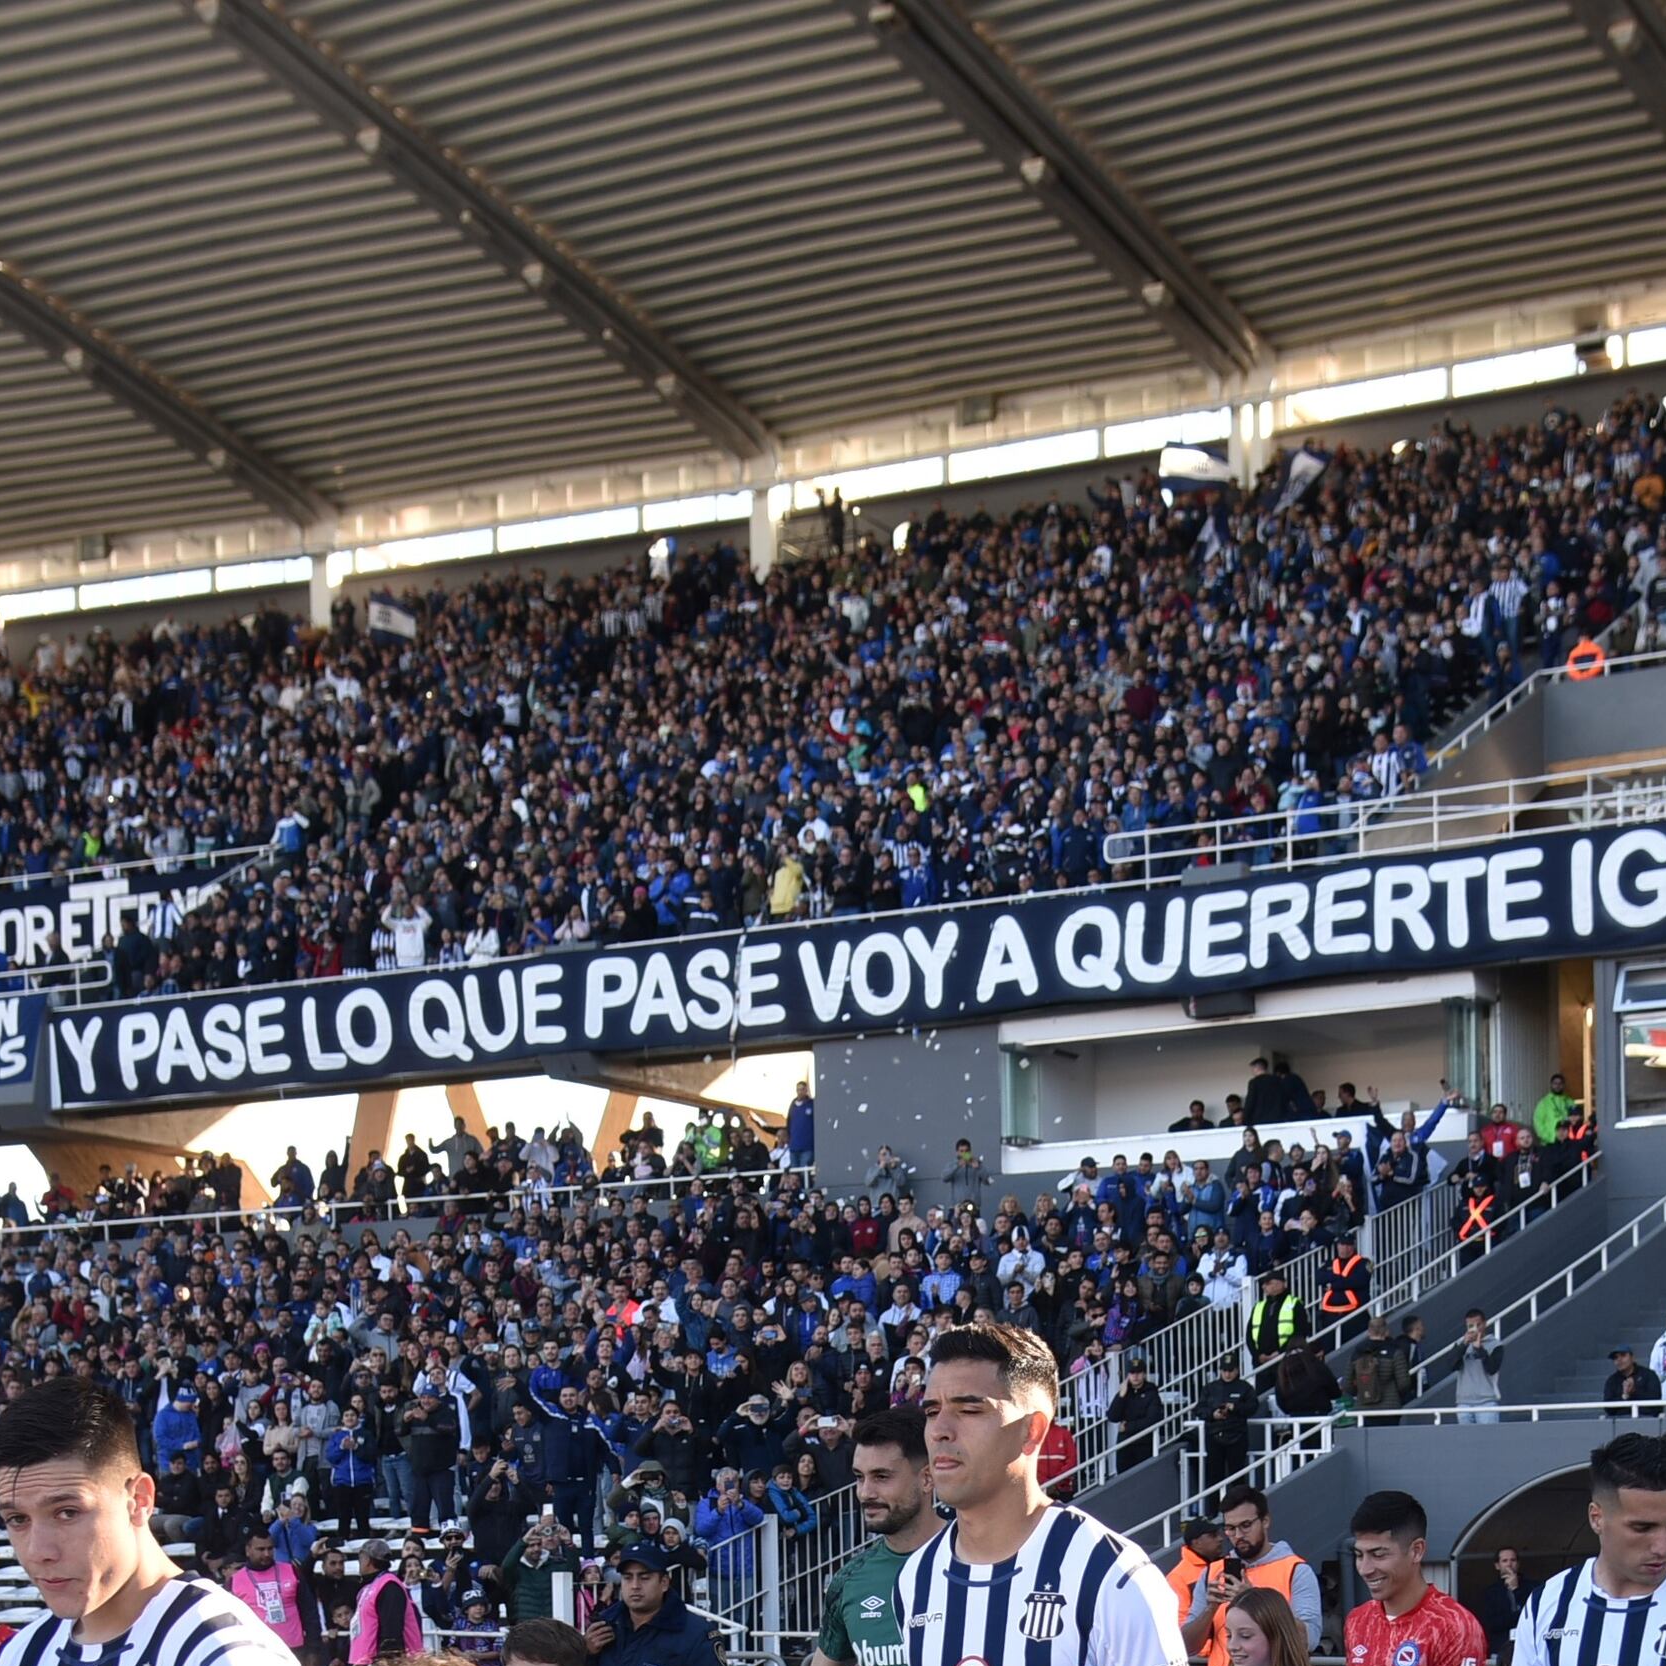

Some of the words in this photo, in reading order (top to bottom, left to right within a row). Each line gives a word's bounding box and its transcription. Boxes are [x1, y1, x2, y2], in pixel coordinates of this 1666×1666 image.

[60, 1016, 102, 1095] Y
[118, 997, 291, 1090] PASE
[302, 987, 392, 1071] LO
[408, 964, 567, 1062] QUE
[584, 943, 786, 1039] PASE
[798, 921, 959, 1023] VOY
[975, 915, 1038, 1003] A
[1055, 847, 1549, 991] QUERERTE
